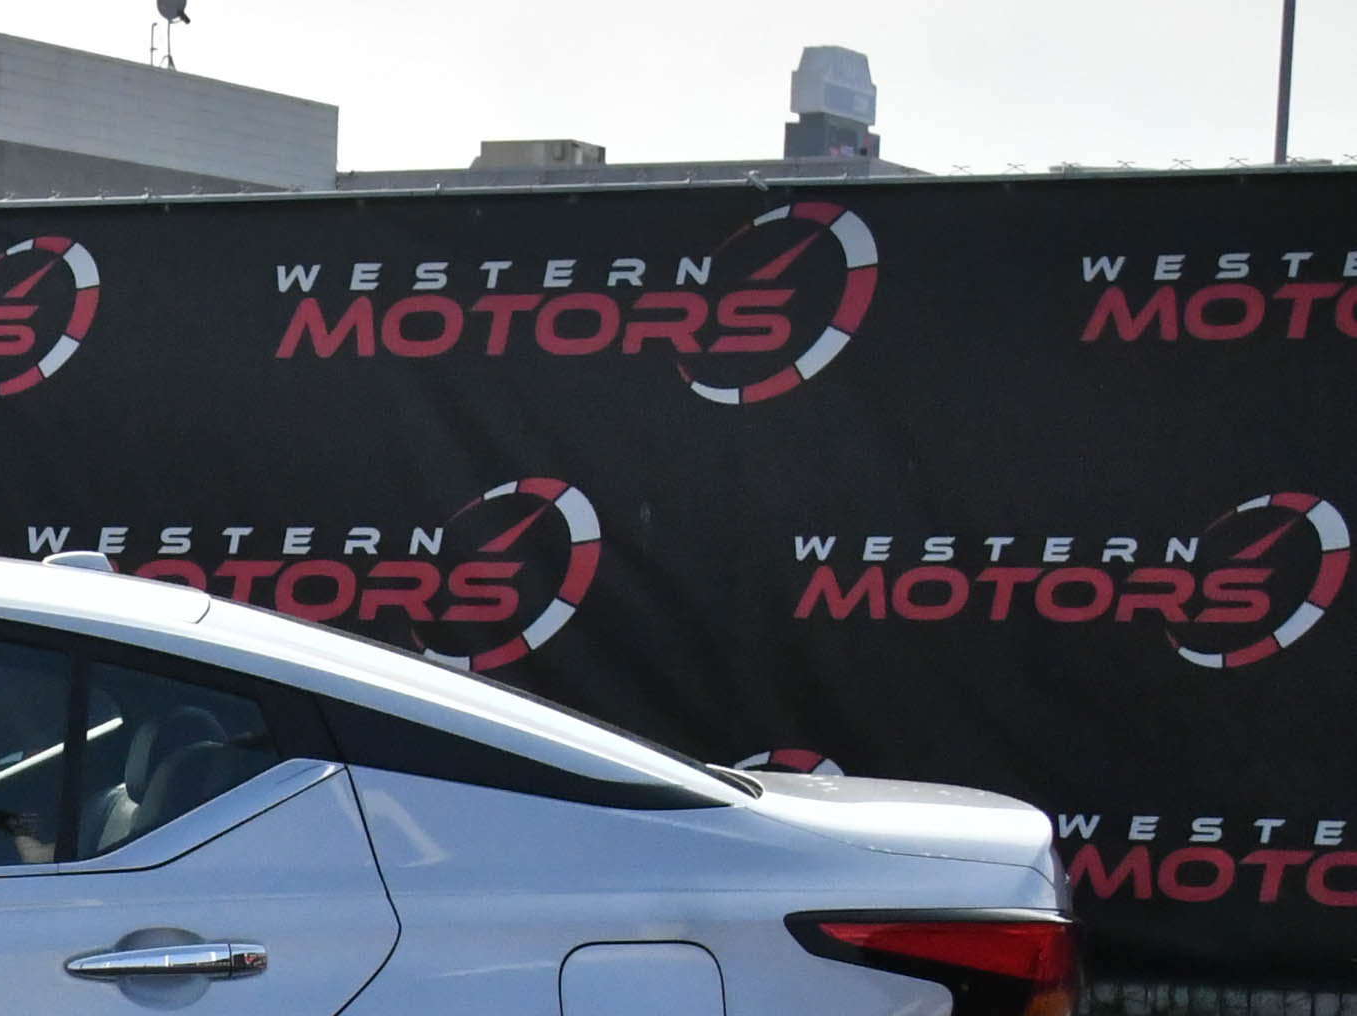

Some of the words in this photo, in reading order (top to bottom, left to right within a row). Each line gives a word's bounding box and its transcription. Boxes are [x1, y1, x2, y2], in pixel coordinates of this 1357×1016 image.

[276, 256, 712, 293] WESTERN
[275, 288, 796, 359] MOTORS
[1081, 282, 1357, 342] MOT
[27, 526, 444, 555] WESTERN
[794, 535, 1199, 563] WESTERN
[794, 565, 1272, 624] MOTORS
